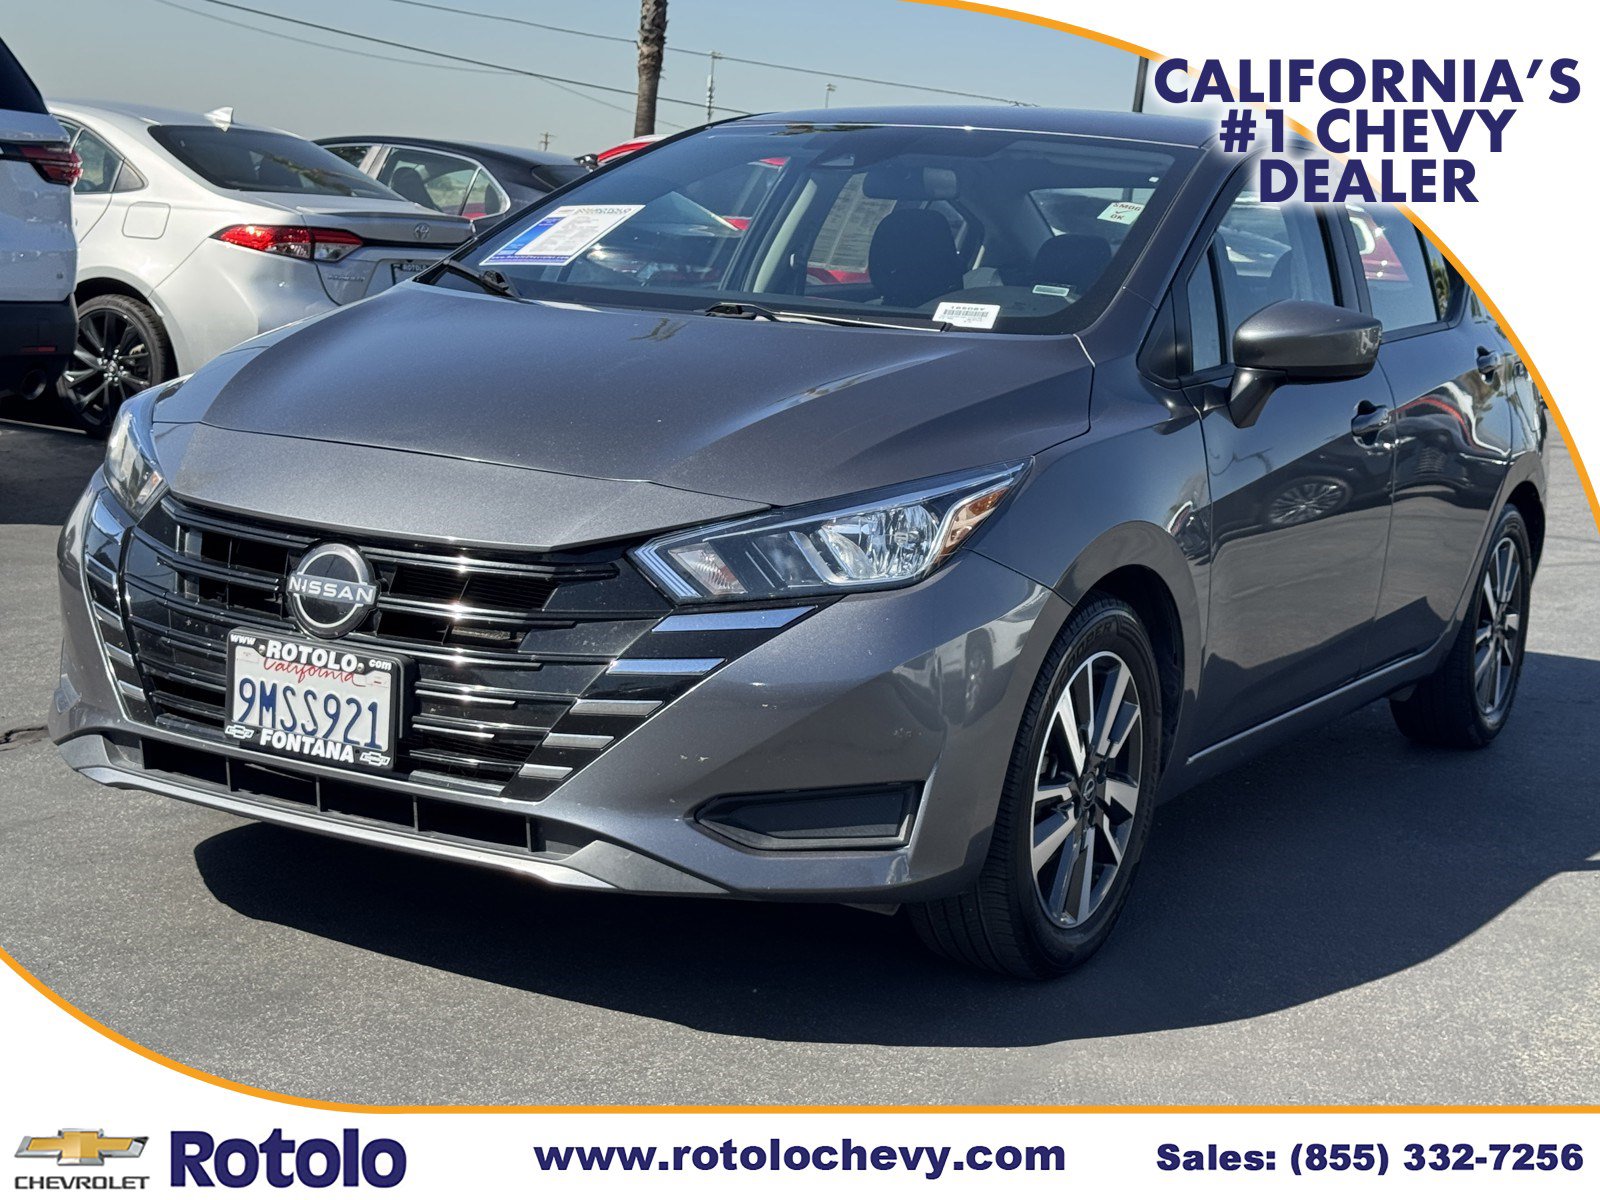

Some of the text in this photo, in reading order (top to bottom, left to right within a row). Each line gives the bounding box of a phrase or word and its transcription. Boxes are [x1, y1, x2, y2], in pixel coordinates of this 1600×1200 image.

[1112, 202, 1142, 212] SMOG
[288, 575, 373, 603] NISSAN
[230, 633, 393, 673] www ROTOLO com
[263, 656, 366, 688] California
[237, 676, 383, 750] 9MSS921
[259, 728, 355, 764] FONTANA
